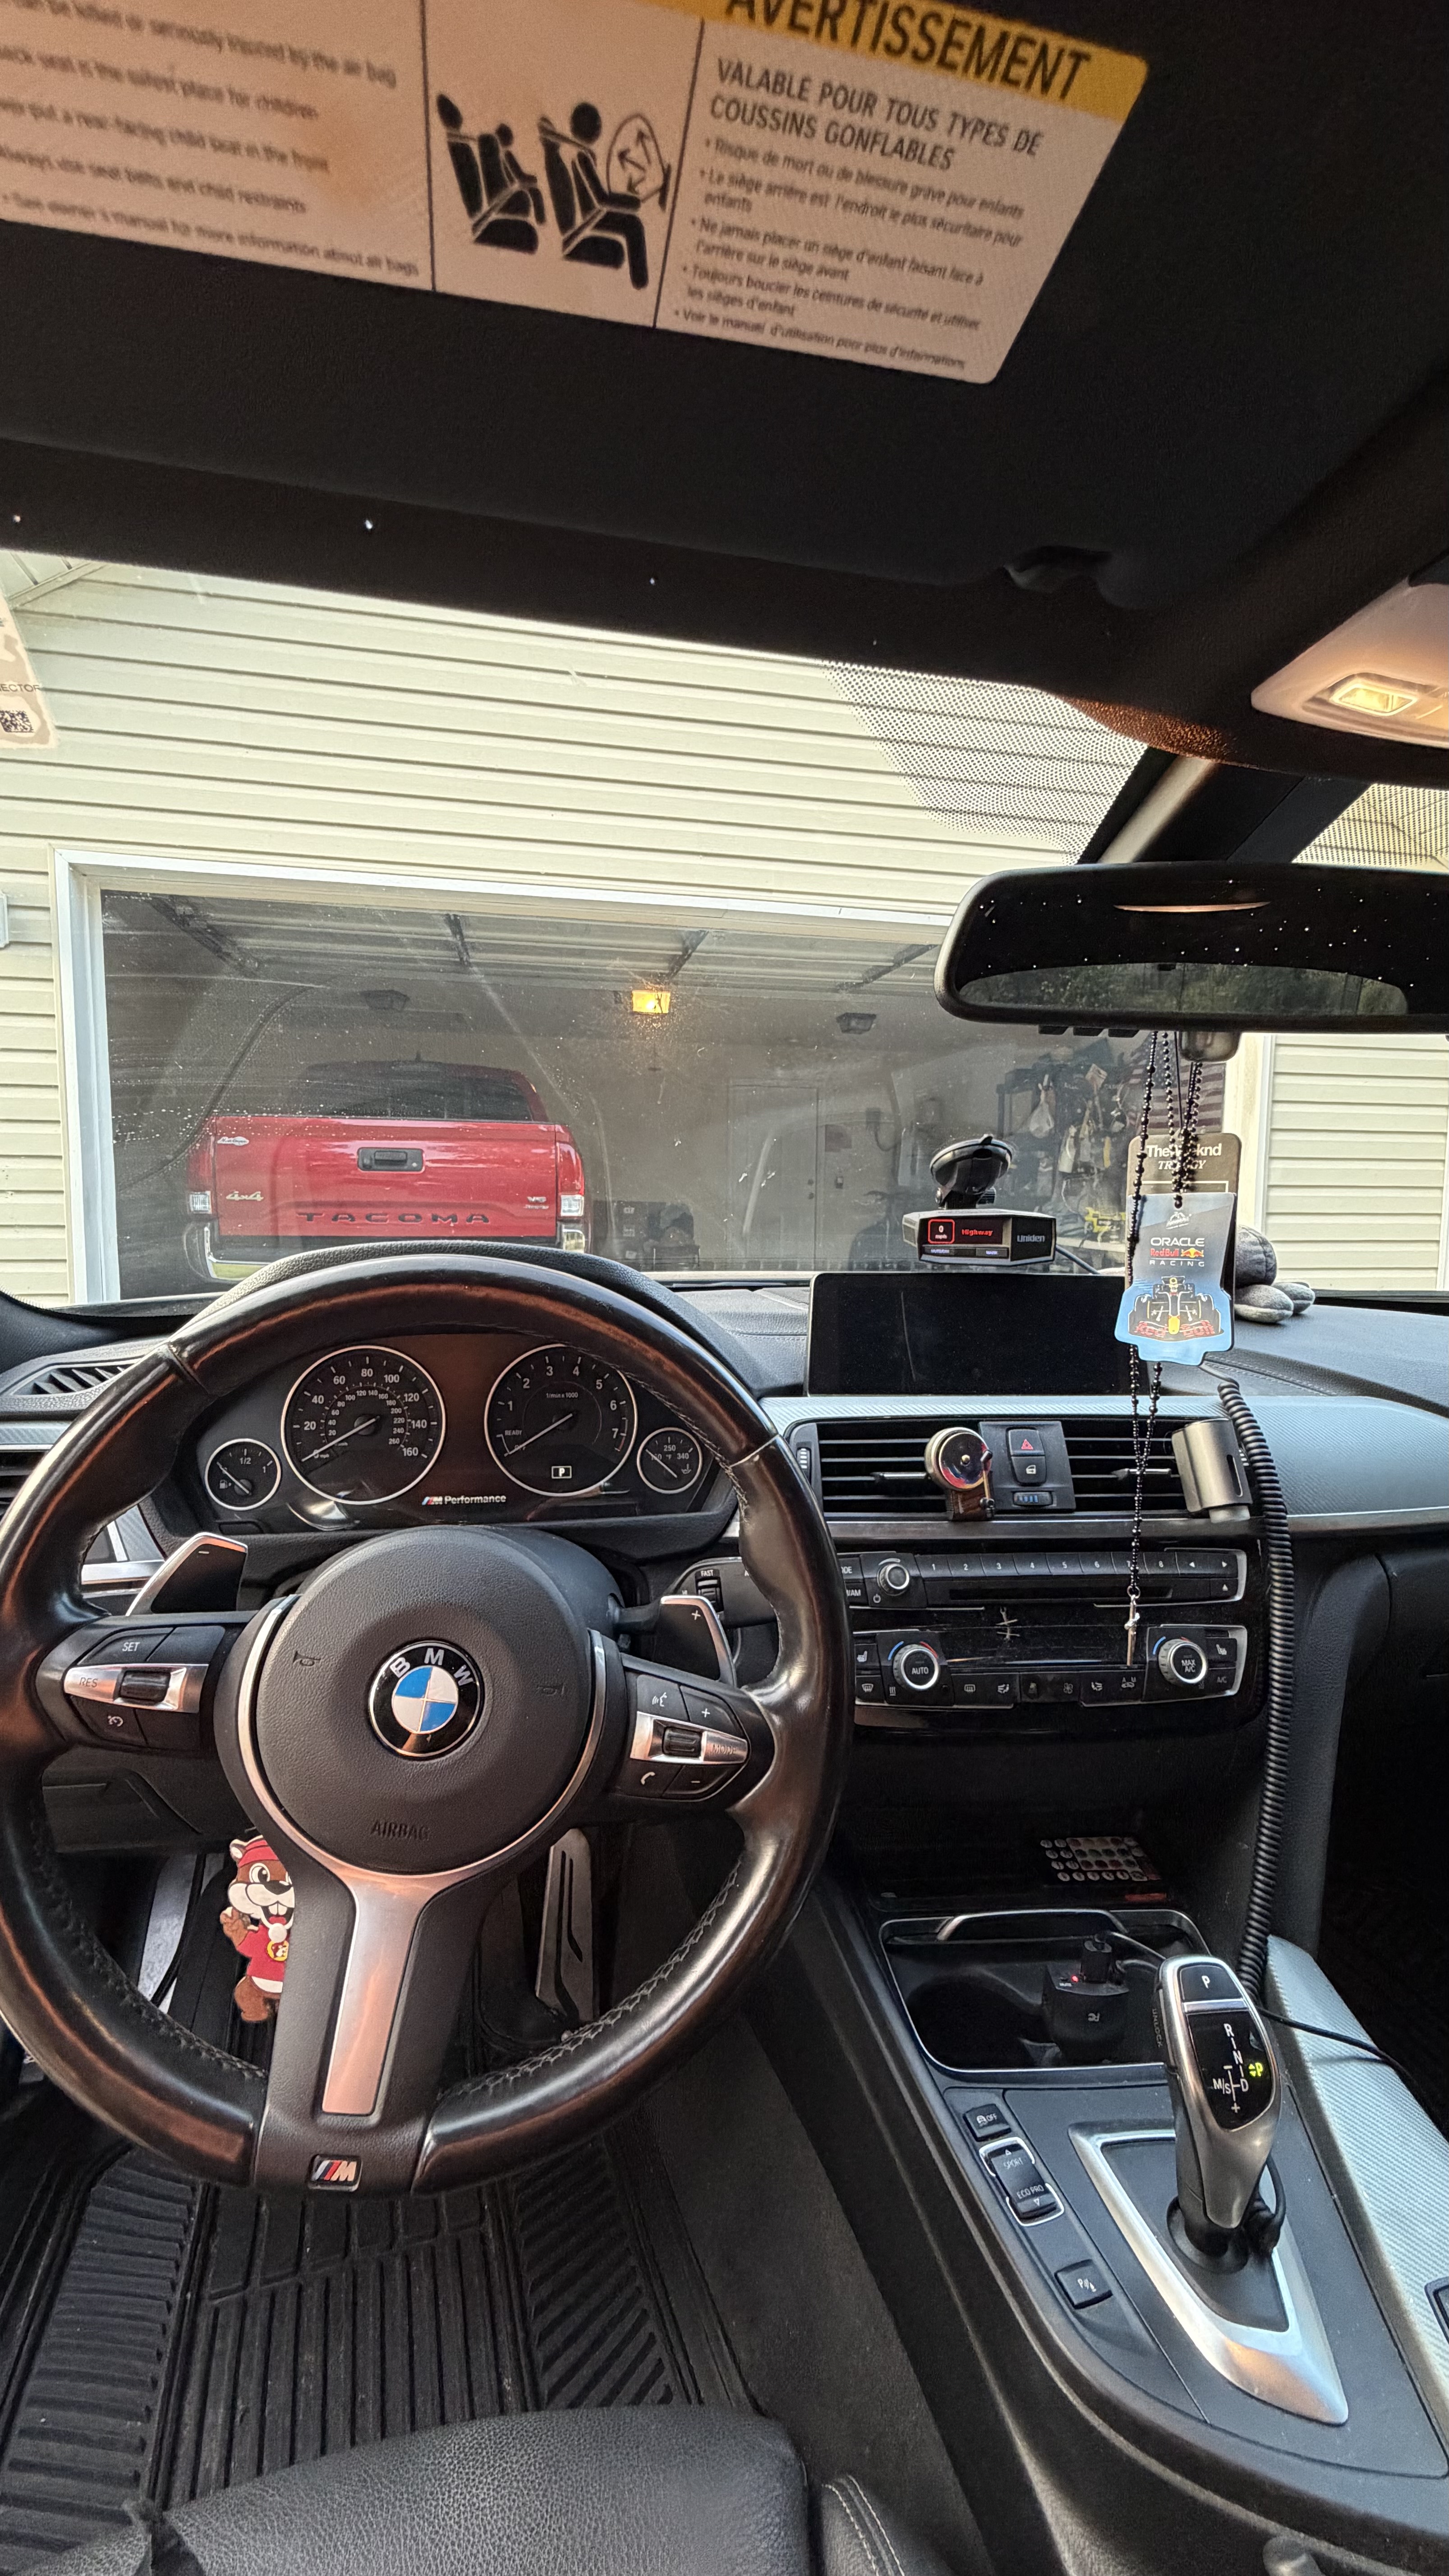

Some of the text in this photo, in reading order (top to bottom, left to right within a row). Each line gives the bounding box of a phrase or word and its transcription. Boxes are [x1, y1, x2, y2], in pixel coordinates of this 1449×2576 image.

[718, 57, 1044, 156] VALABLE POUR TOUS TYPES DE
[710, 94, 955, 170] COUSSINS GONFLABLES
[296, 1212, 490, 1224] TACOMA
[1017, 1234, 1045, 1242] Uniden
[1150, 1237, 1205, 1247] ORACLE
[361, 1368, 373, 1377] 80
[546, 1366, 553, 1376] 3
[572, 1366, 580, 1376] 4
[333, 1375, 345, 1385] 60
[383, 1374, 400, 1383] 100
[523, 1378, 530, 1389] 2
[596, 1379, 603, 1390] 5
[311, 1395, 324, 1404] 40
[404, 1393, 419, 1402] 120
[507, 1400, 513, 1411] 1
[610, 1400, 617, 1411] 6
[304, 1421, 316, 1431] 20
[411, 1419, 427, 1429] 140
[612, 1428, 619, 1439] 7
[402, 1447, 419, 1456] 160
[558, 1467, 565, 1477] P
[445, 1495, 506, 1505] Performance
[122, 1642, 140, 1652] SET
[392, 1647, 474, 1687] BMW
[911, 1666, 929, 1674] AUTO
[79, 1677, 98, 1688] RES
[712, 1743, 737, 1755] MODE
[370, 1820, 430, 1841] AIRBAG
[1201, 1975, 1210, 1989] P
[1224, 2023, 1234, 2037] R
[1233, 2050, 1243, 2064] N
[1255, 2062, 1263, 2077] P
[1240, 2079, 1249, 2092] D
[986, 2113, 998, 2122] OFF
[1003, 2157, 1024, 2170] SPORT
[1017, 2185, 1044, 2199] ECO PRO
